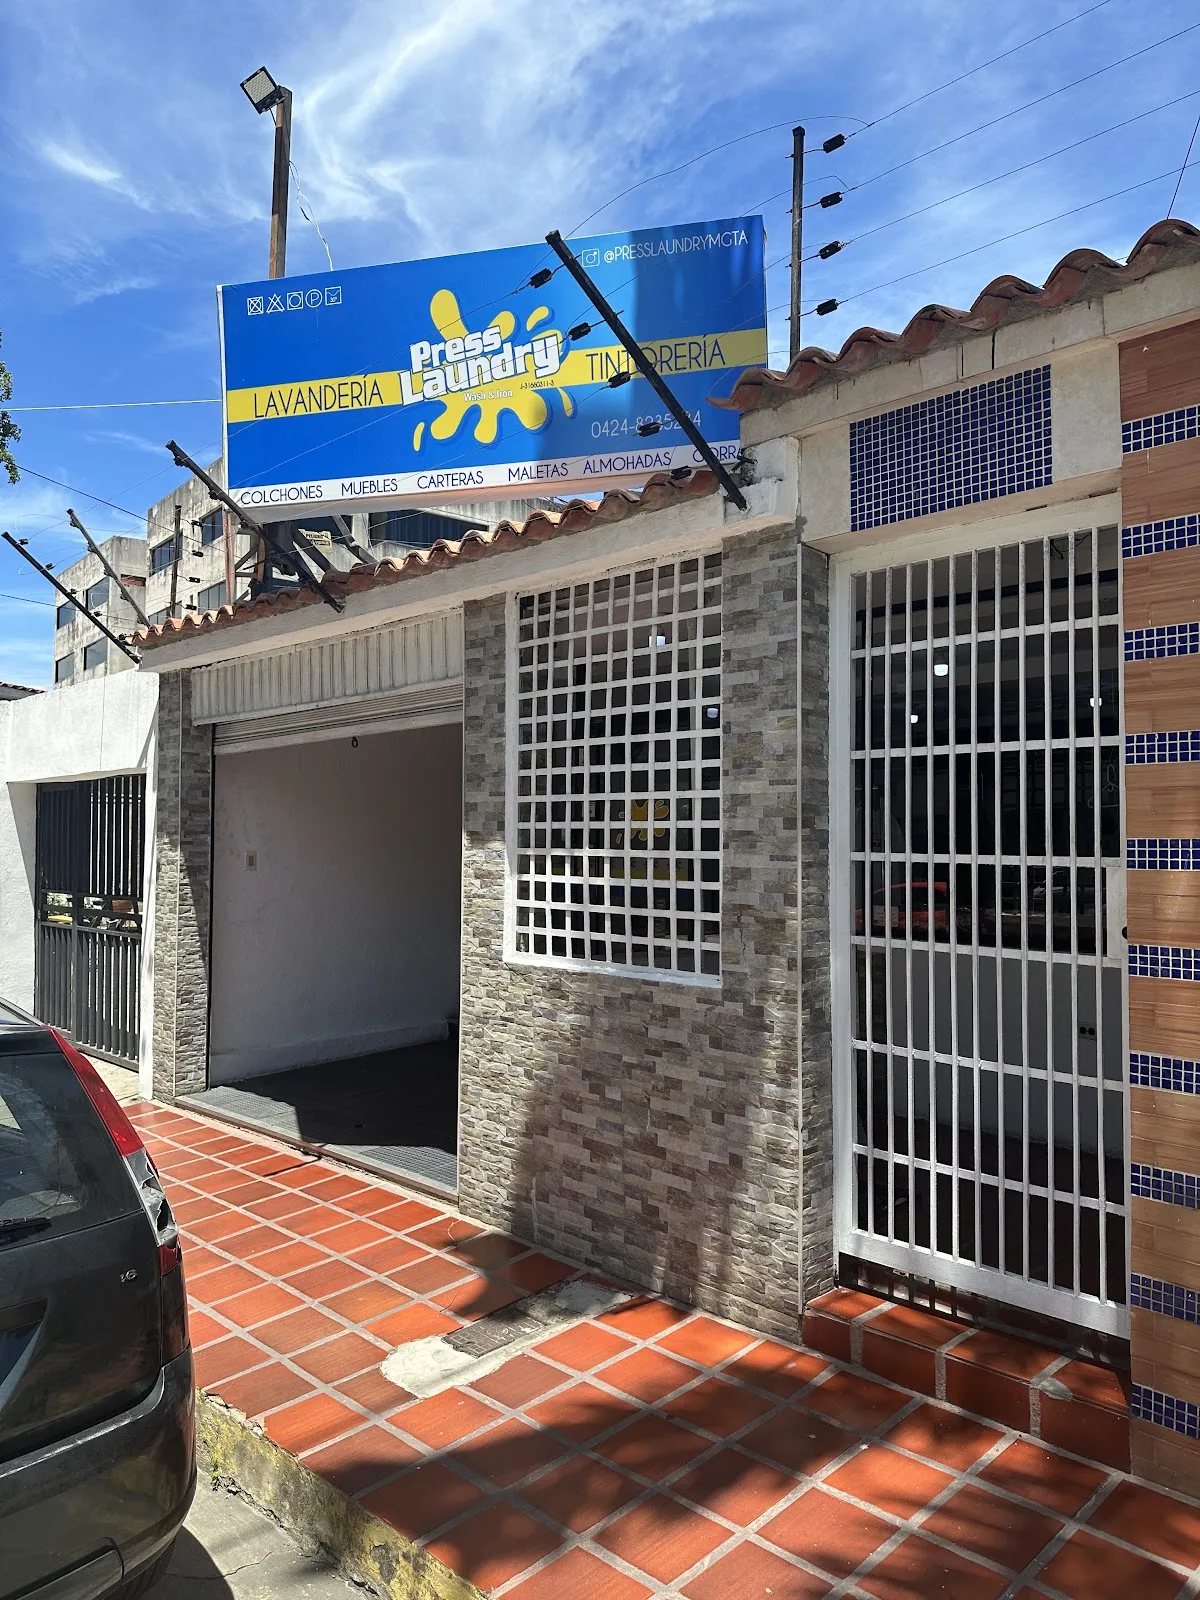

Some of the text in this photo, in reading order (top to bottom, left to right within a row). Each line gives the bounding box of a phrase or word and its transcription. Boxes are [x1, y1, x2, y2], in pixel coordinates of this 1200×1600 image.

[604, 229, 749, 264] @PRESSLAUNDRYMGTA
[398, 333, 561, 406] Laundry
[410, 325, 502, 373] Press
[586, 334, 726, 380] TINTORERÍA
[254, 374, 384, 418] LAVANDERÍA
[463, 388, 513, 402] Wash & Iron
[591, 409, 702, 438] 0424-8354
[240, 485, 323, 505] COLCHONES
[341, 478, 398, 496] MUEBLES
[417, 470, 484, 489] CARTERAS
[508, 463, 569, 482] MALETAS
[583, 452, 672, 475] ALMOHADAS
